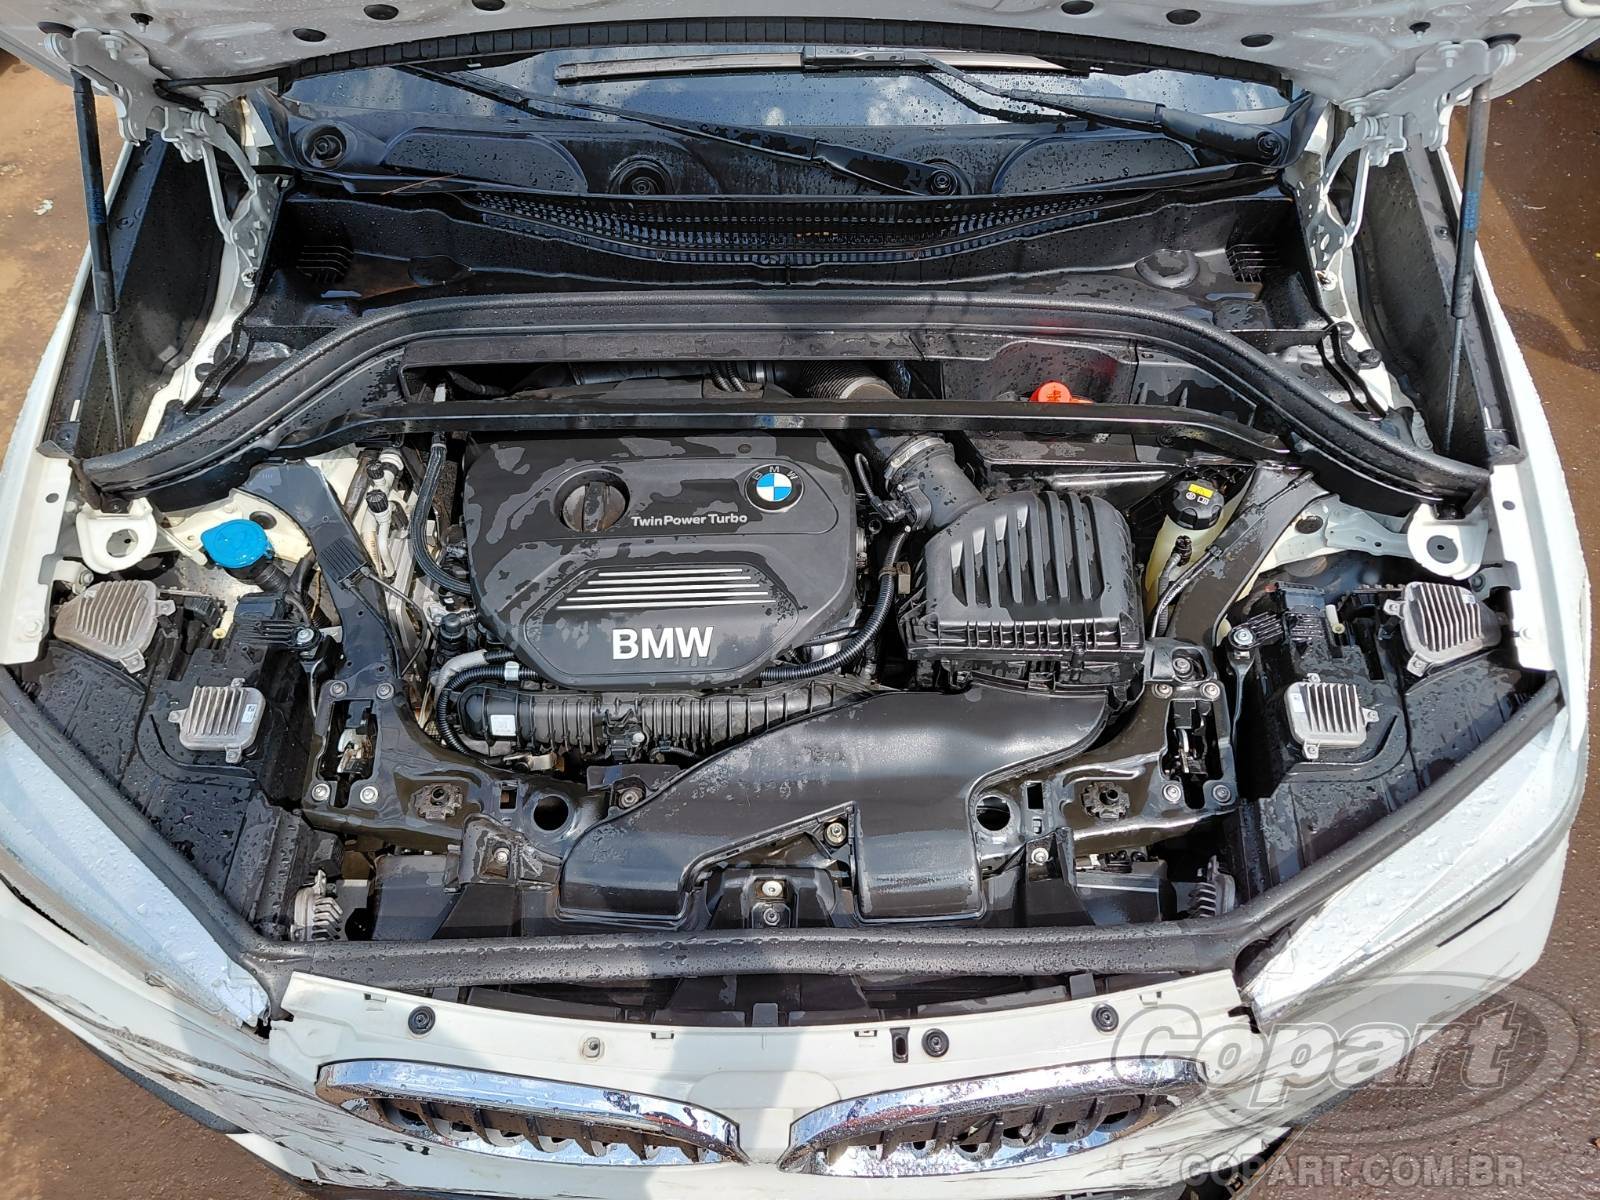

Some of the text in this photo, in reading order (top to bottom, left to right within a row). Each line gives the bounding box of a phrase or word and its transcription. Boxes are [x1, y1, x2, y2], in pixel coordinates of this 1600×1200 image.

[752, 466, 798, 480] BMW
[708, 513, 748, 524] Turbo
[612, 626, 714, 659] BMW
